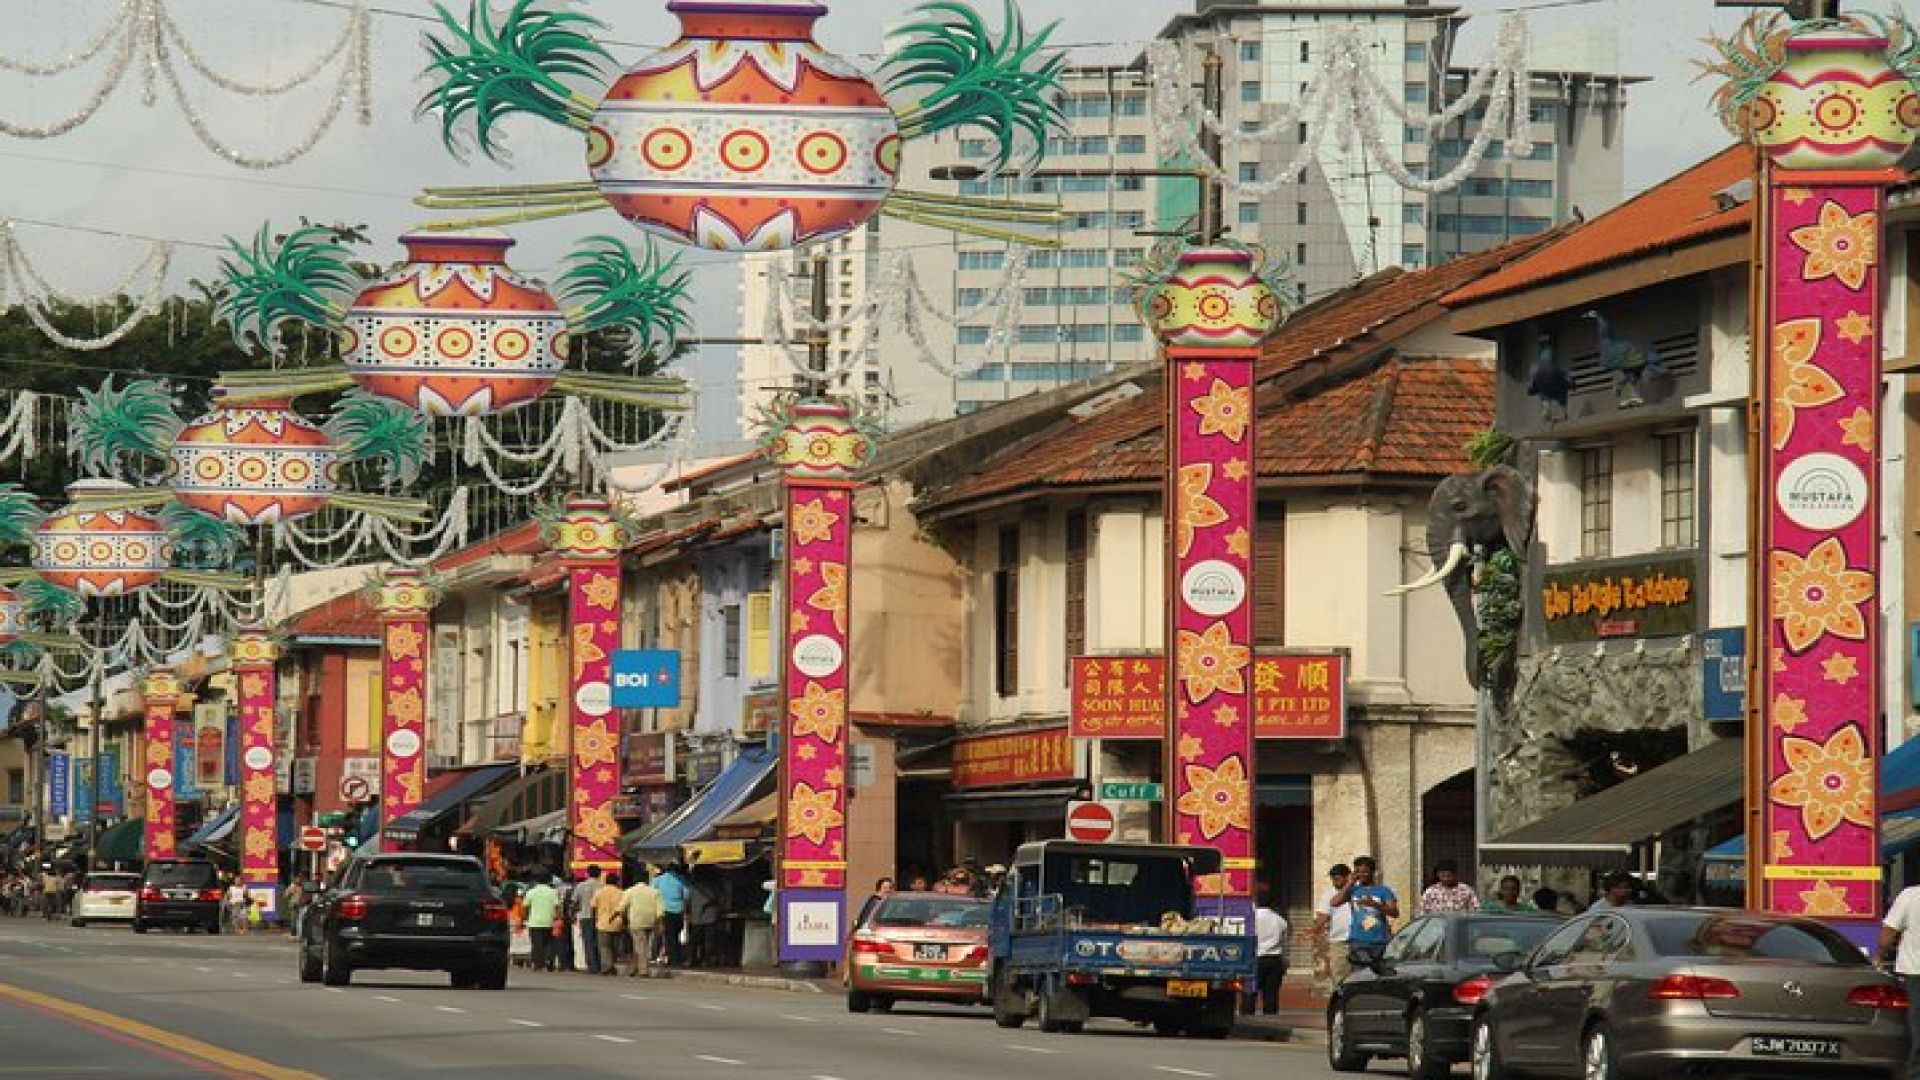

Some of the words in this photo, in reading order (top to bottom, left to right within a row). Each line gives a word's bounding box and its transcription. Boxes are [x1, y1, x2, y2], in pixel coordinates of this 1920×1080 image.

[1789, 492, 1854, 502] MUSTAFA
[615, 672, 647, 687] BOI
[1082, 699, 1122, 712] SOON
[1269, 697, 1295, 712] PTE
[1302, 697, 1331, 712] LTD
[1105, 783, 1148, 798] Cuff
